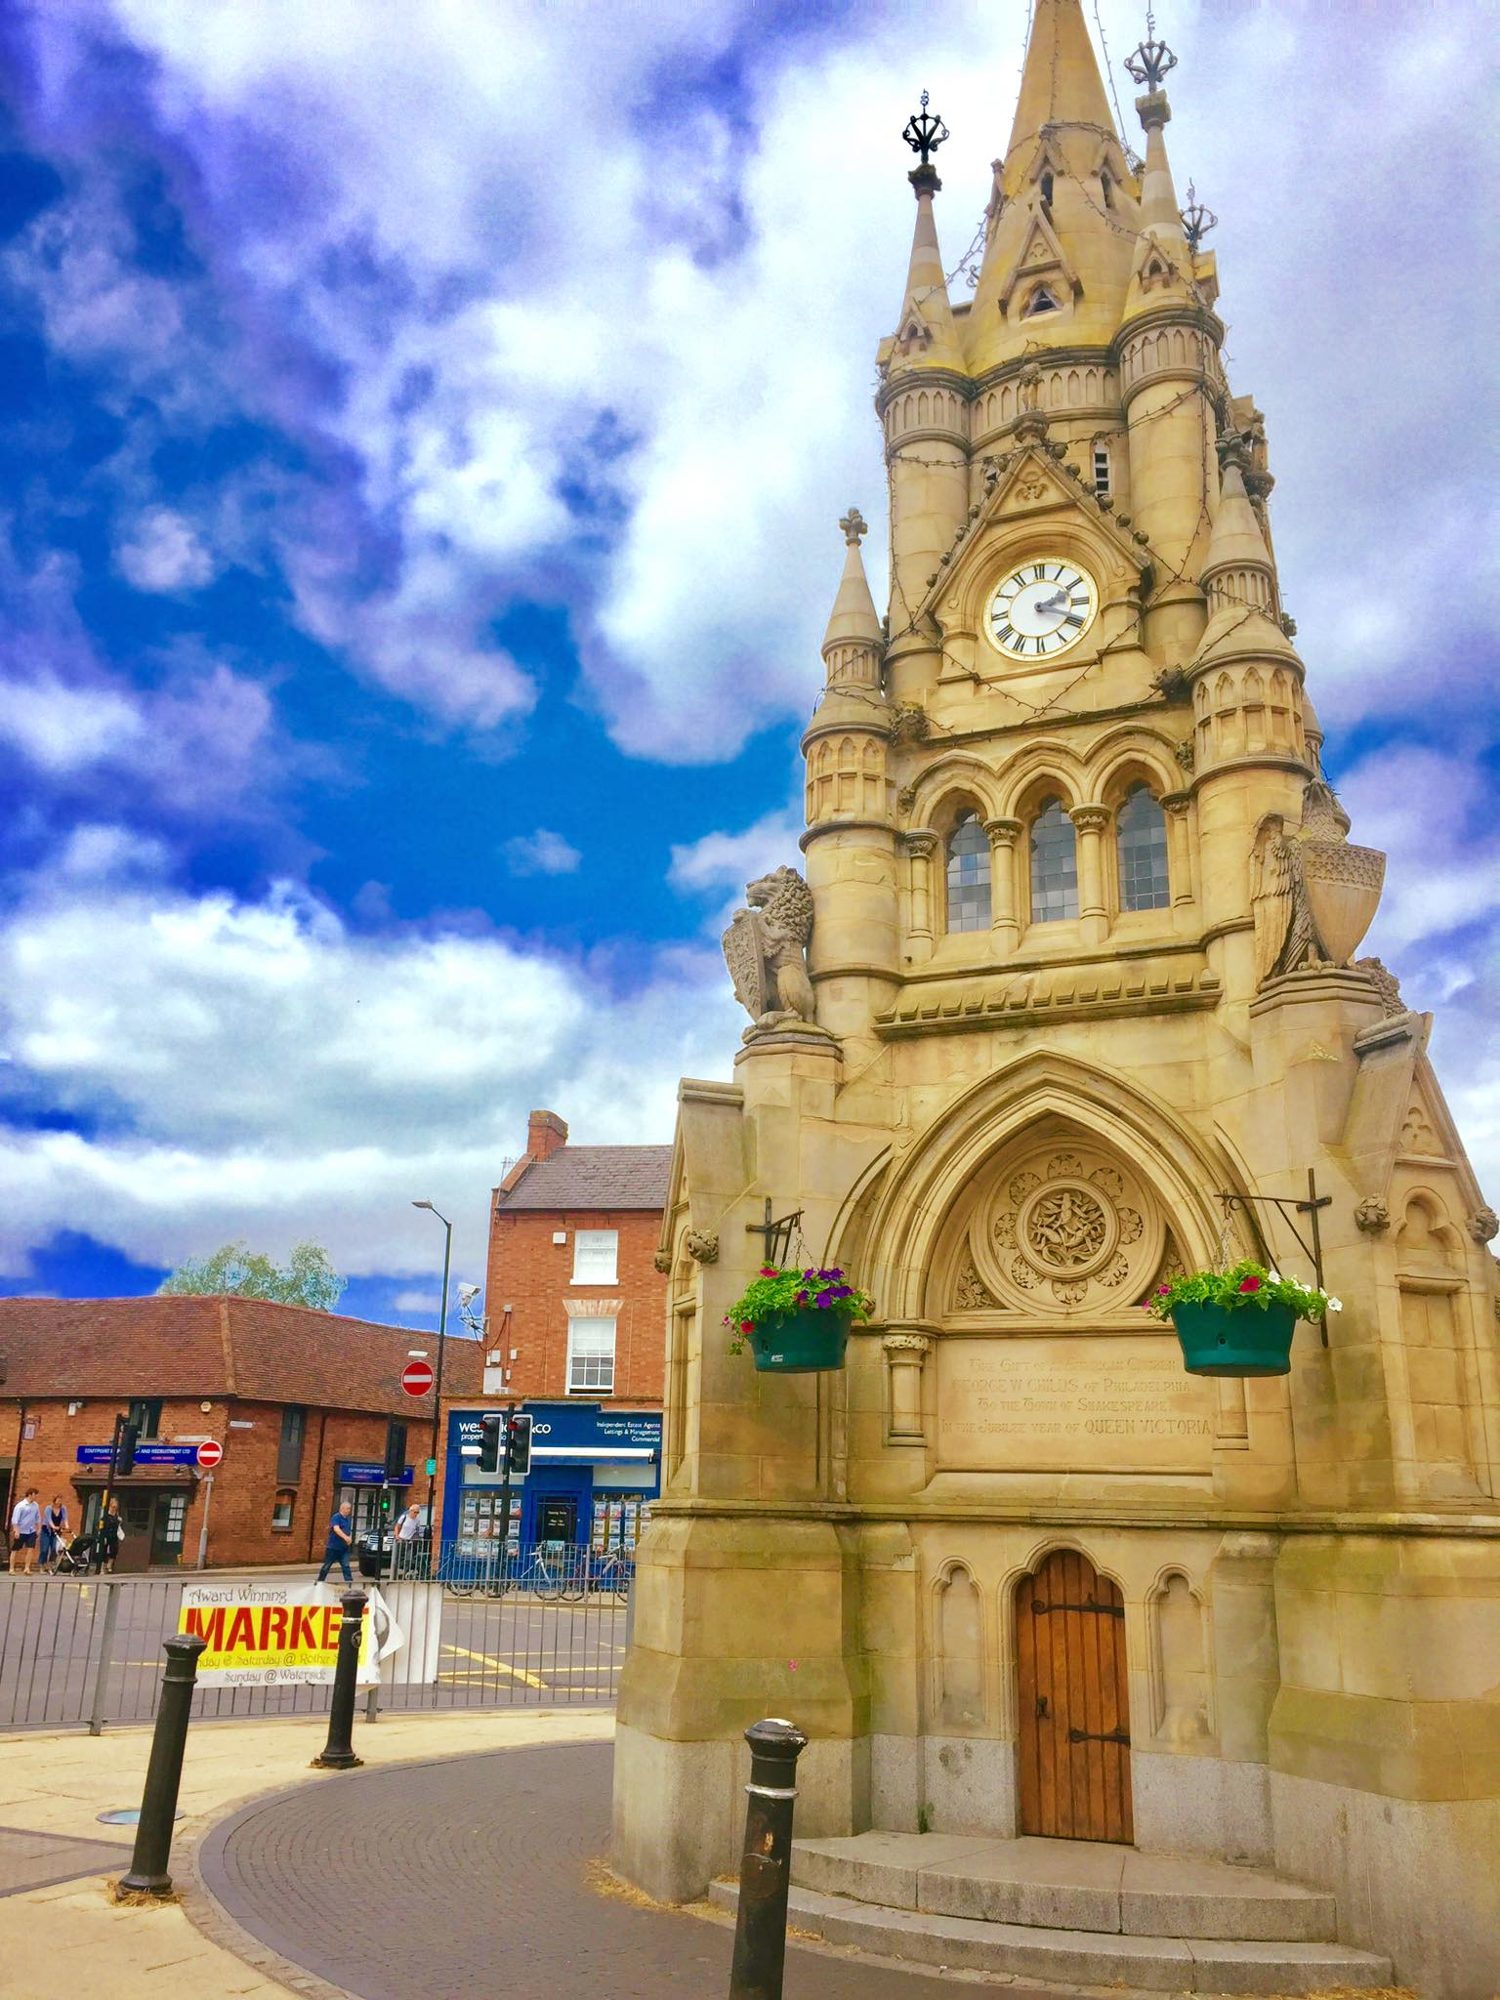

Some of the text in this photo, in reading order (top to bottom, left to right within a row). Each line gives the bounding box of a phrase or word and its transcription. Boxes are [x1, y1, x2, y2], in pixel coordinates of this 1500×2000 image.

[189, 1588, 288, 1605] Award Winning
[185, 1605, 369, 1652] MARKE
[264, 1669, 278, 1684] @
